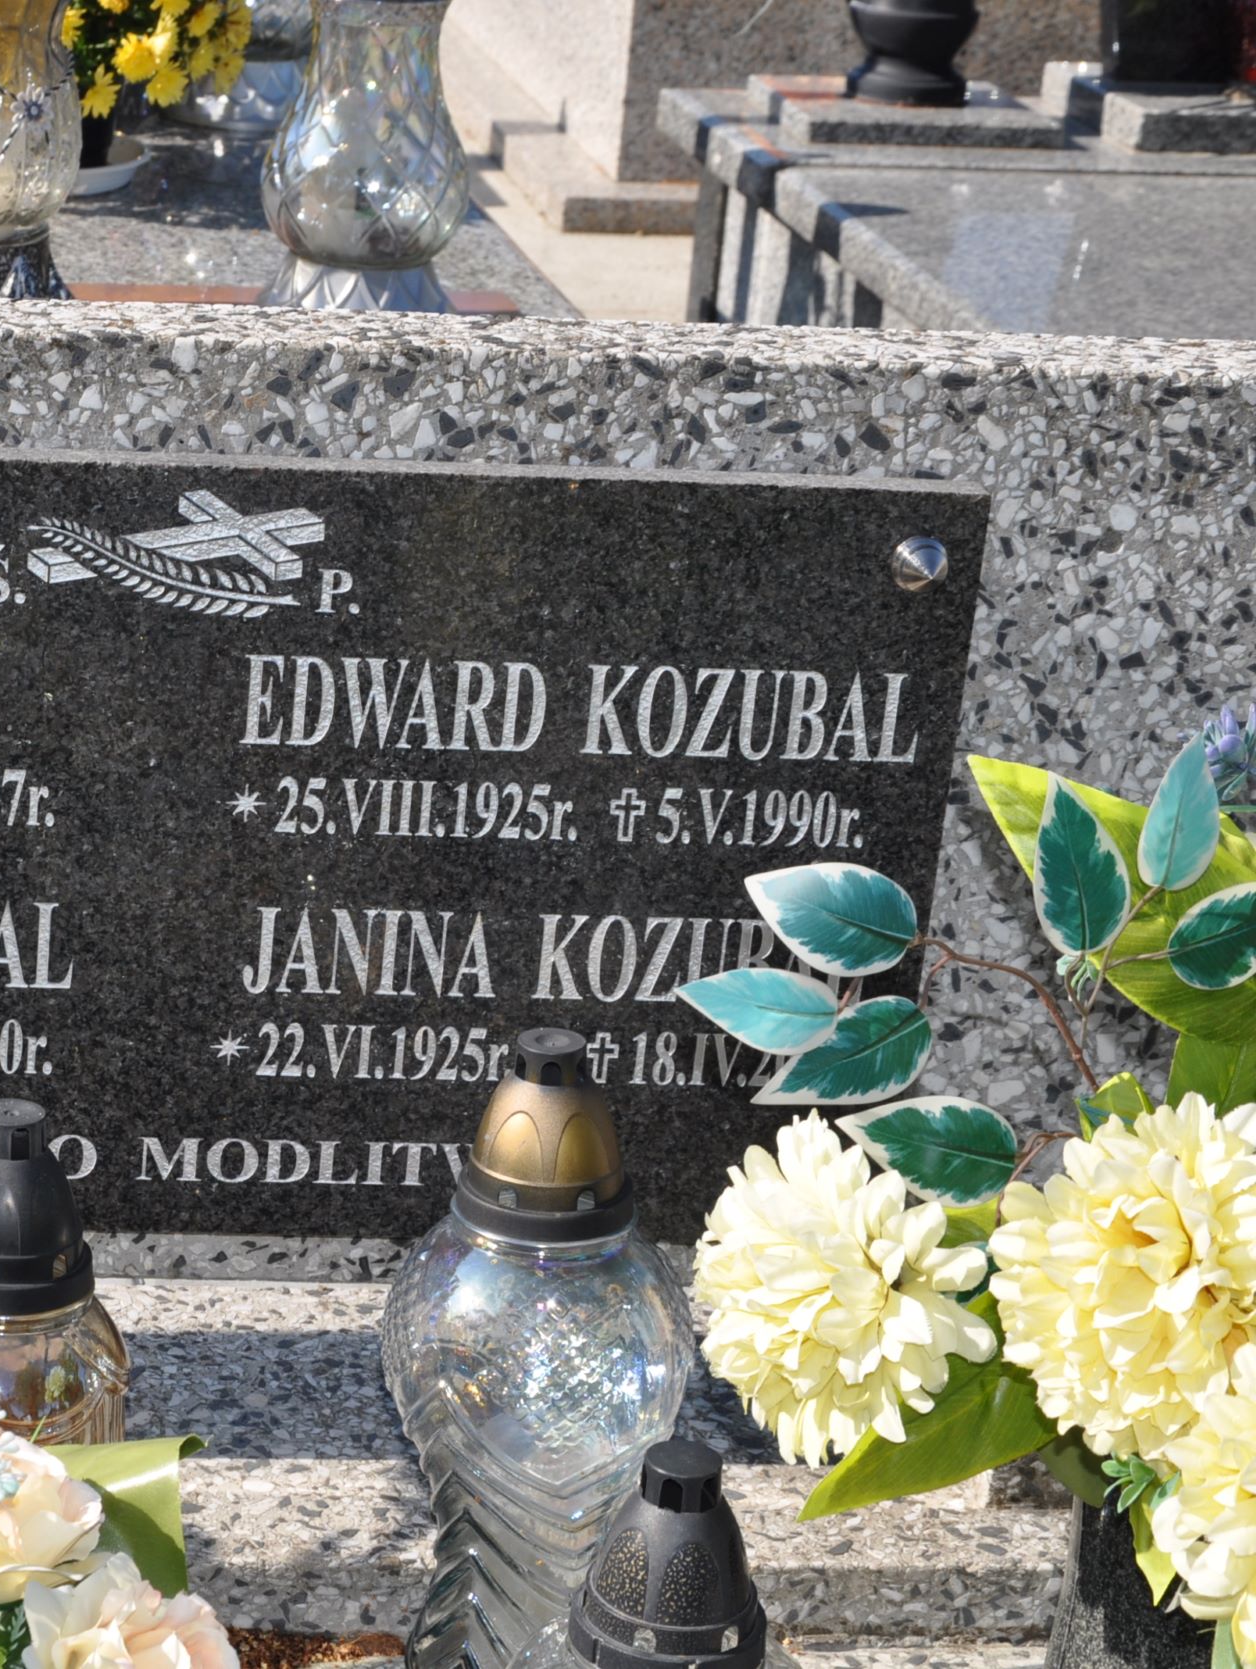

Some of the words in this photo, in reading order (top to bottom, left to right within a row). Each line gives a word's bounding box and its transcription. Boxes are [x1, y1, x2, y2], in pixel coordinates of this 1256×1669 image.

[318, 569, 360, 614] P.
[240, 654, 547, 752] EDWARD
[580, 664, 918, 763] KOZUBAL
[274, 776, 577, 842] 25.VIII.1925r.
[656, 787, 863, 848] 5.V.1990r.
[243, 906, 496, 999] JANINA
[531, 914, 863, 1002] KOZUB
[135, 1137, 472, 1187] MODLIT
